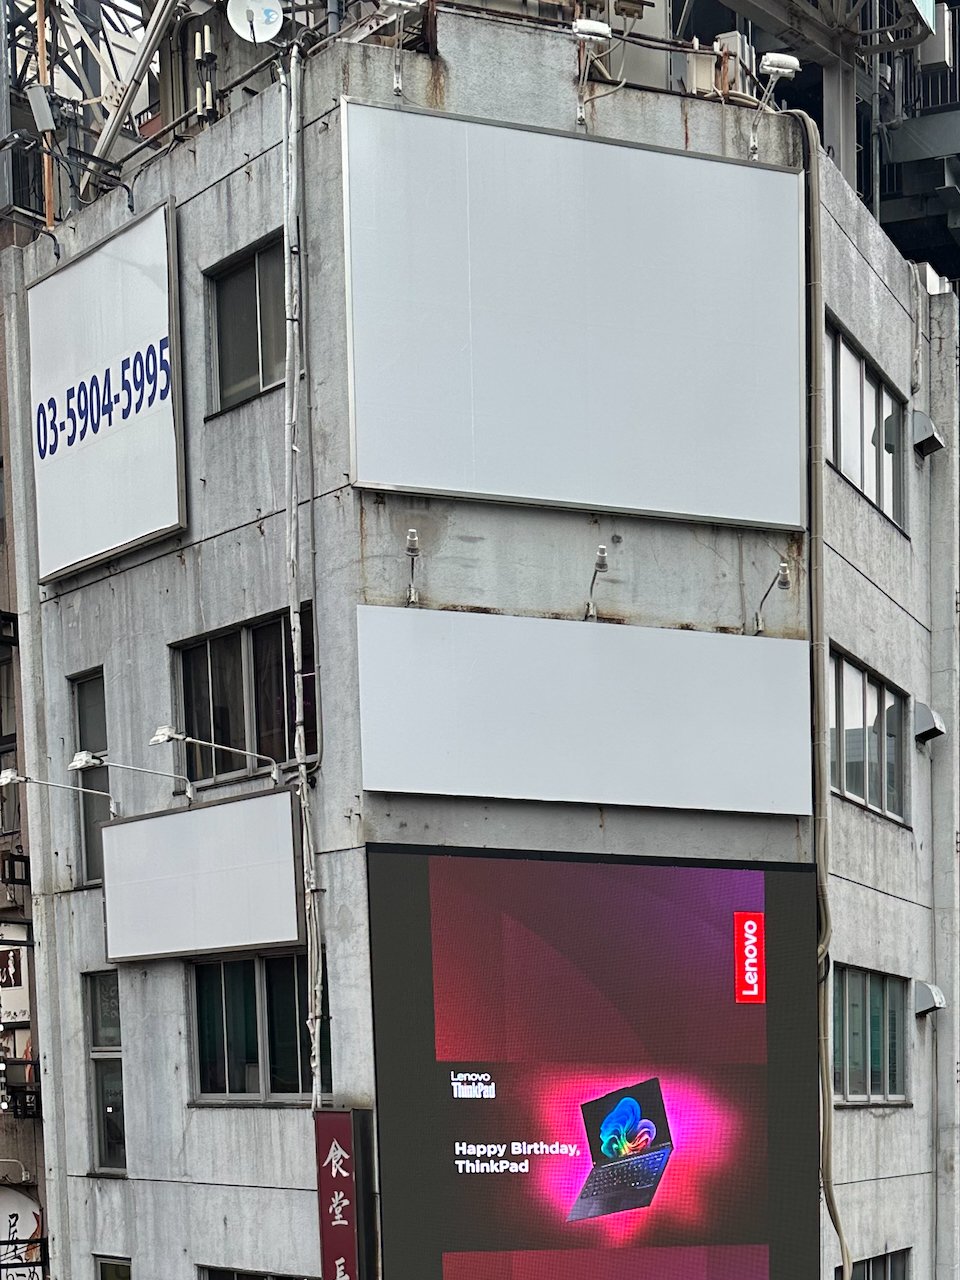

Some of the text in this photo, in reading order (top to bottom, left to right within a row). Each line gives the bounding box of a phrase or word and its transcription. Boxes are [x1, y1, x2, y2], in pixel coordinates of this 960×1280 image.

[37, 336, 171, 459] 03-5904-5995
[742, 920, 759, 995] Lenovo
[451, 1070, 491, 1081] Lenovo
[451, 1082, 496, 1098] ThinkPad
[455, 1142, 581, 1157] Happy Birthday,
[455, 1159, 529, 1173] ThinkPad
[322, 1138, 350, 1226] 食堂
